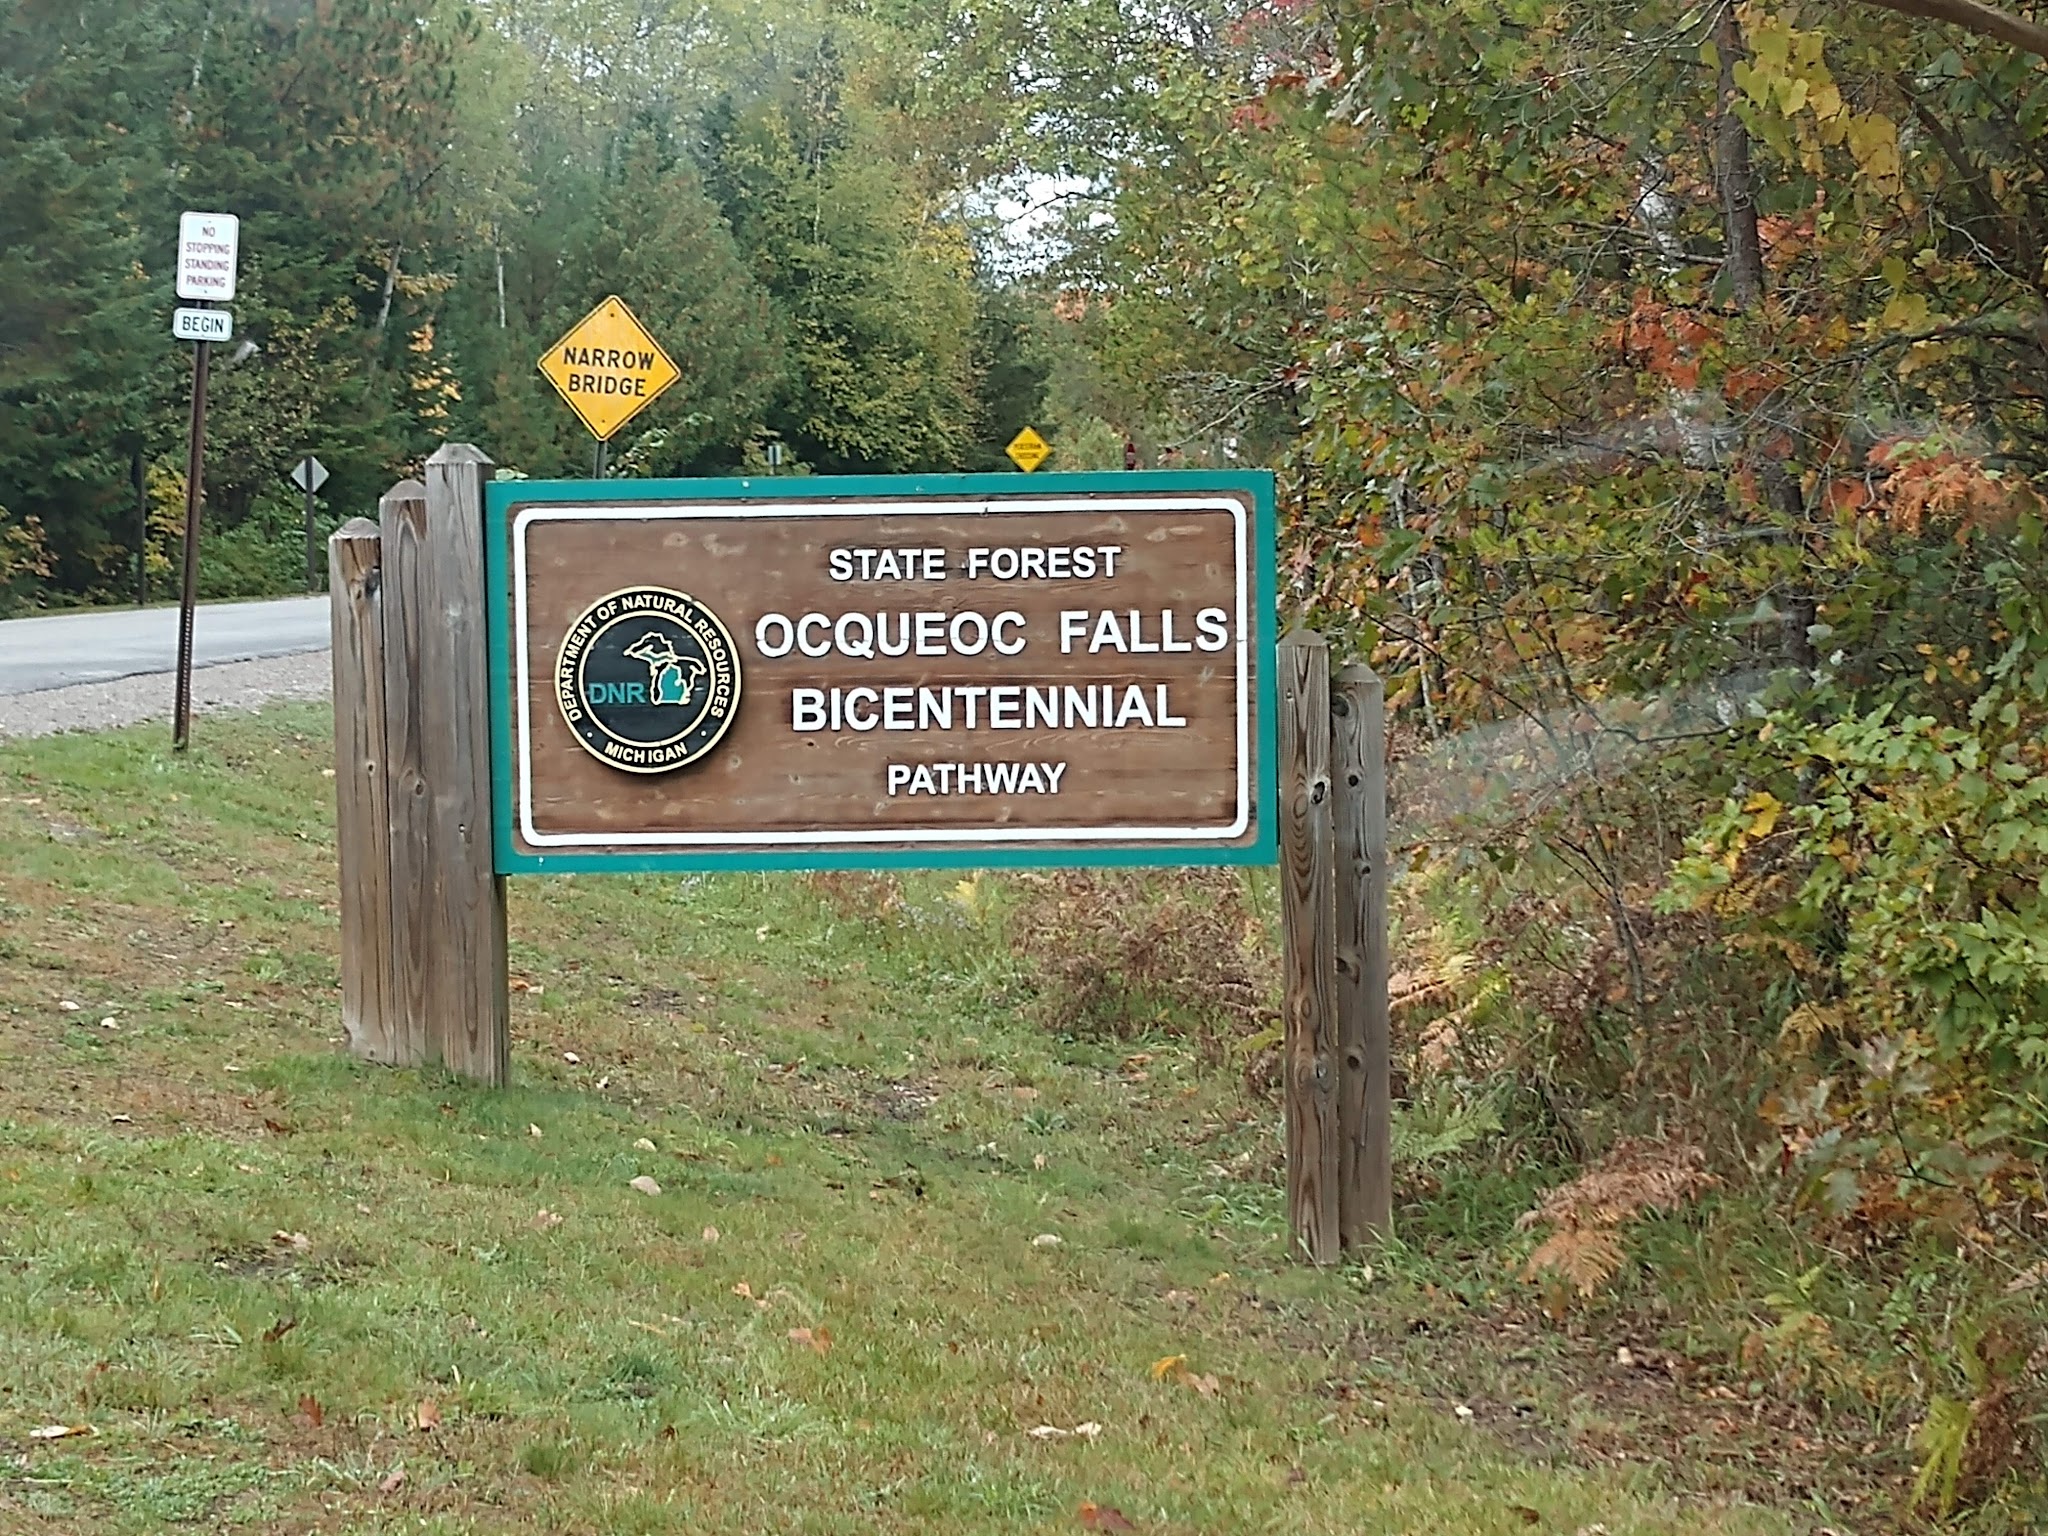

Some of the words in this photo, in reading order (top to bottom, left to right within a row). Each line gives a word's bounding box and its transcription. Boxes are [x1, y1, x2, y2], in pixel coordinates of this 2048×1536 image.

[202, 226, 216, 238] NO
[186, 241, 230, 255] STOPPING
[185, 258, 229, 272] STANDING
[186, 274, 226, 288] PARKING
[182, 315, 224, 333] BEGIN
[563, 346, 655, 371] NARROW
[568, 373, 646, 397] BRIDGE
[828, 547, 946, 582] STATE
[967, 545, 1122, 579] FOREST
[754, 609, 1027, 660] OCQUEOC
[1059, 607, 1229, 655] FALLS
[559, 617, 598, 722] DEPARTMENT
[596, 601, 617, 621] OF
[621, 594, 693, 624] NATURAL
[694, 618, 731, 718] RESOURCES
[588, 682, 646, 704] DNR
[791, 684, 1187, 732] BICENTENNIAL
[604, 741, 688, 763] MICHIGAN
[887, 762, 1067, 796] PATHWAY
